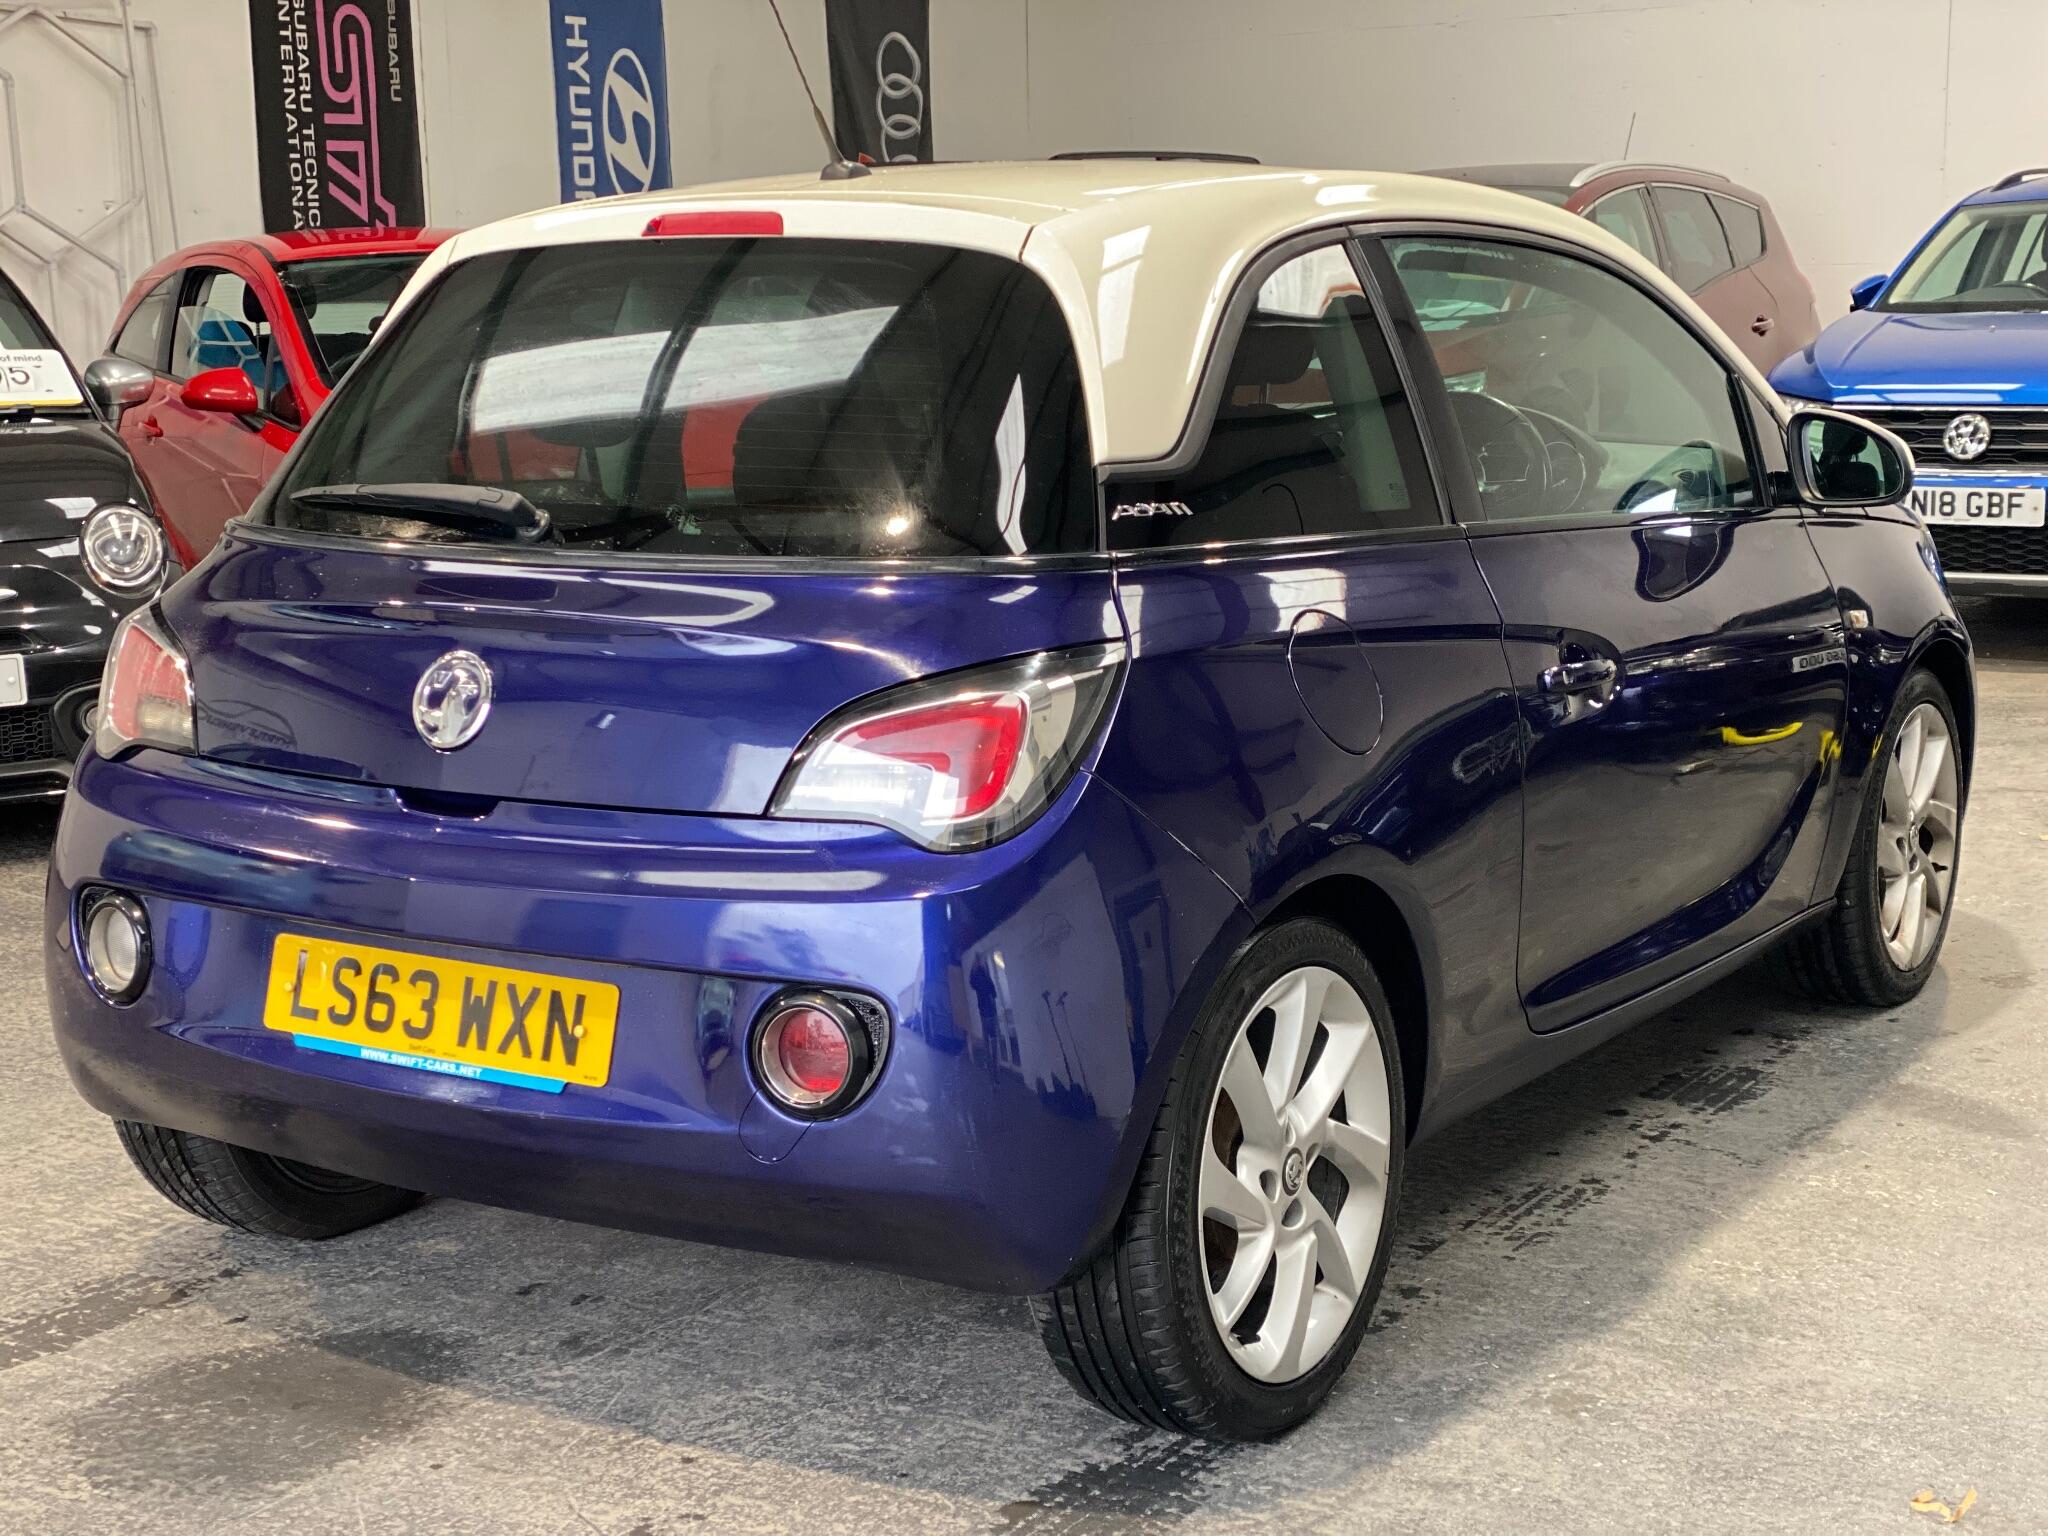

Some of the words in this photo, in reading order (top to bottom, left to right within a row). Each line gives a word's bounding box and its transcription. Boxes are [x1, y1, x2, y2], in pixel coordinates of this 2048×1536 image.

[386, 0, 402, 102] SUBARU
[0, 367, 30, 385] 5
[1966, 491, 2025, 518] GBF
[290, 949, 440, 1040] LS63
[457, 976, 586, 1067] WXN
